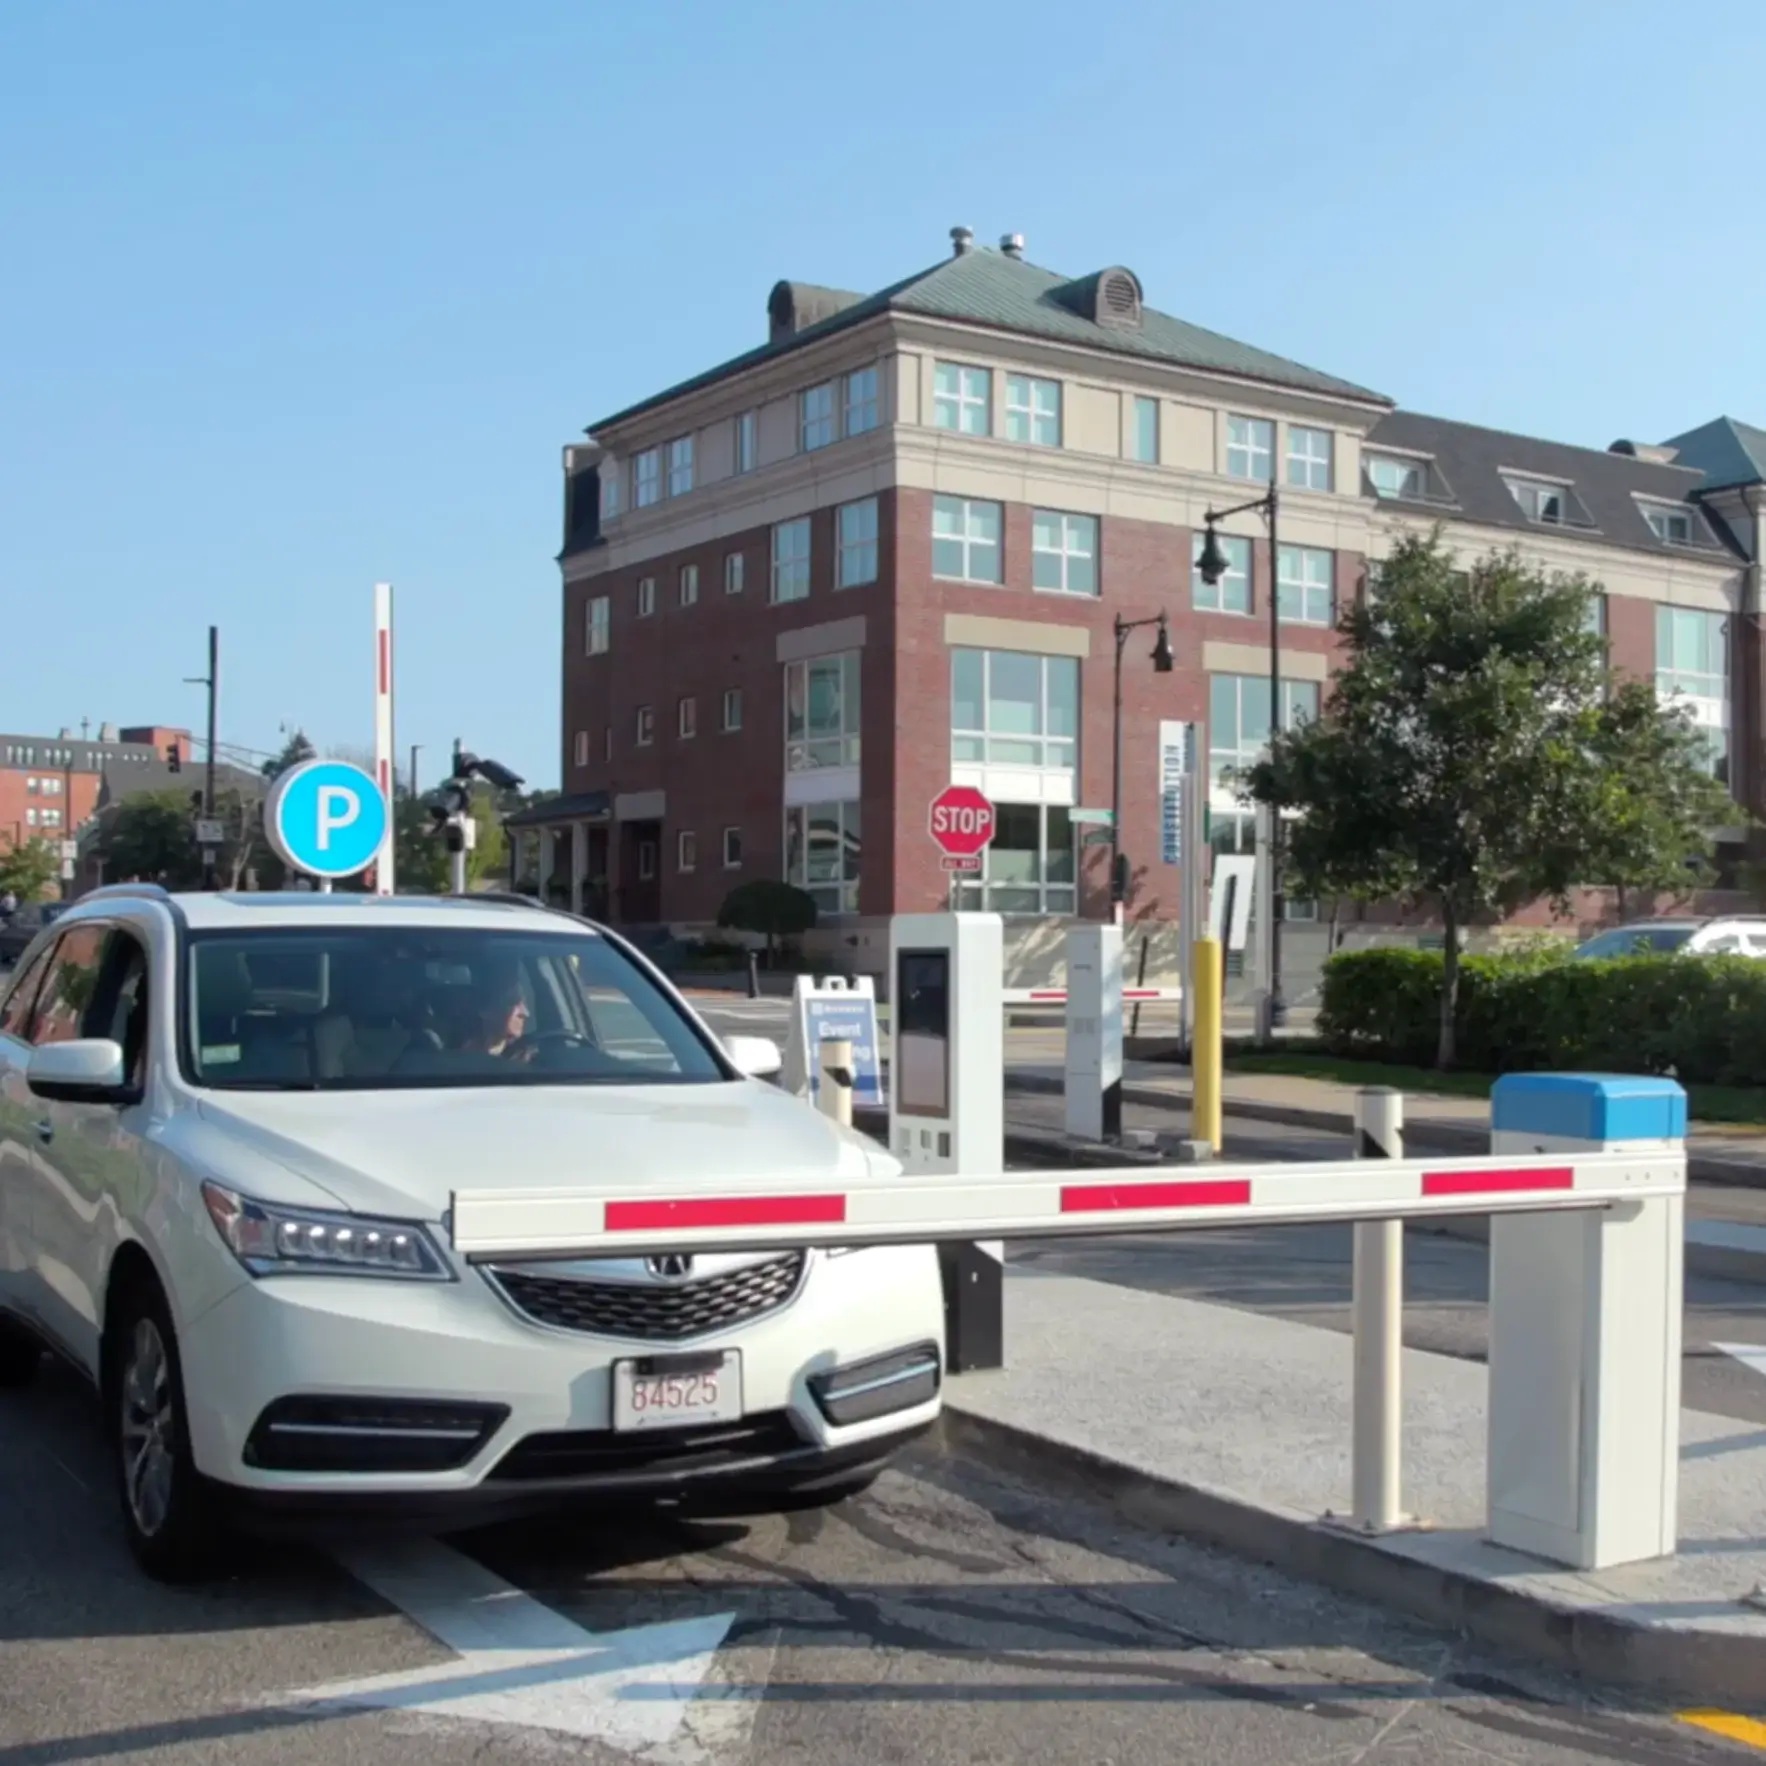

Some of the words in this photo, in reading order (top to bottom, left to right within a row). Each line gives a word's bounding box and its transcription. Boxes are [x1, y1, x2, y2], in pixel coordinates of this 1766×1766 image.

[317, 785, 360, 850] P
[933, 806, 990, 835] STOP
[1163, 744, 1181, 864] CONSTITUTION
[819, 1020, 861, 1037] Event
[632, 1371, 717, 1411] 84525
